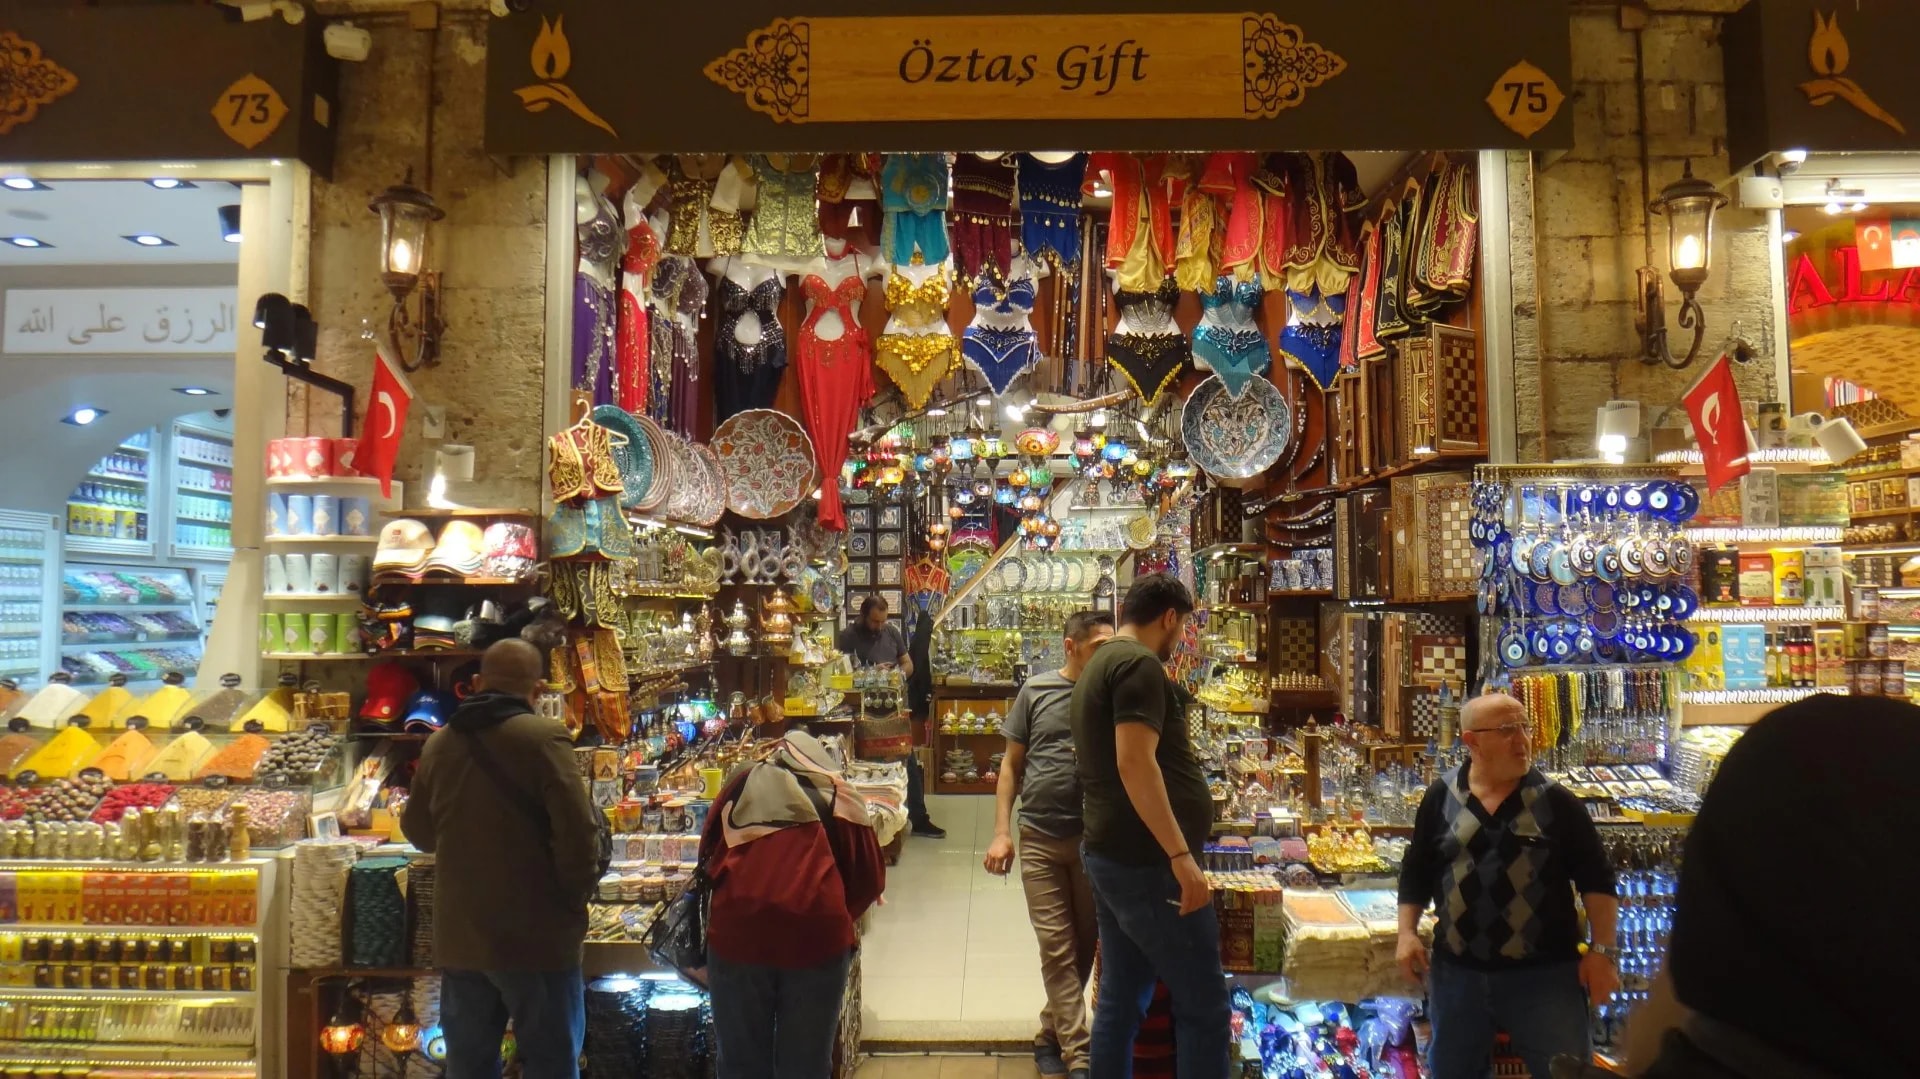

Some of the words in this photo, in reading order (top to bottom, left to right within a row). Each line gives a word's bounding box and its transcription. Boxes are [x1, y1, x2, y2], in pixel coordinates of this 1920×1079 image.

[898, 39, 1038, 87] Öztaş
[1056, 39, 1150, 96] Gift
[229, 93, 270, 127] 73
[1503, 82, 1548, 116] 75
[17, 305, 55, 334] الله
[66, 303, 126, 346] على
[142, 302, 235, 344] الرزق
